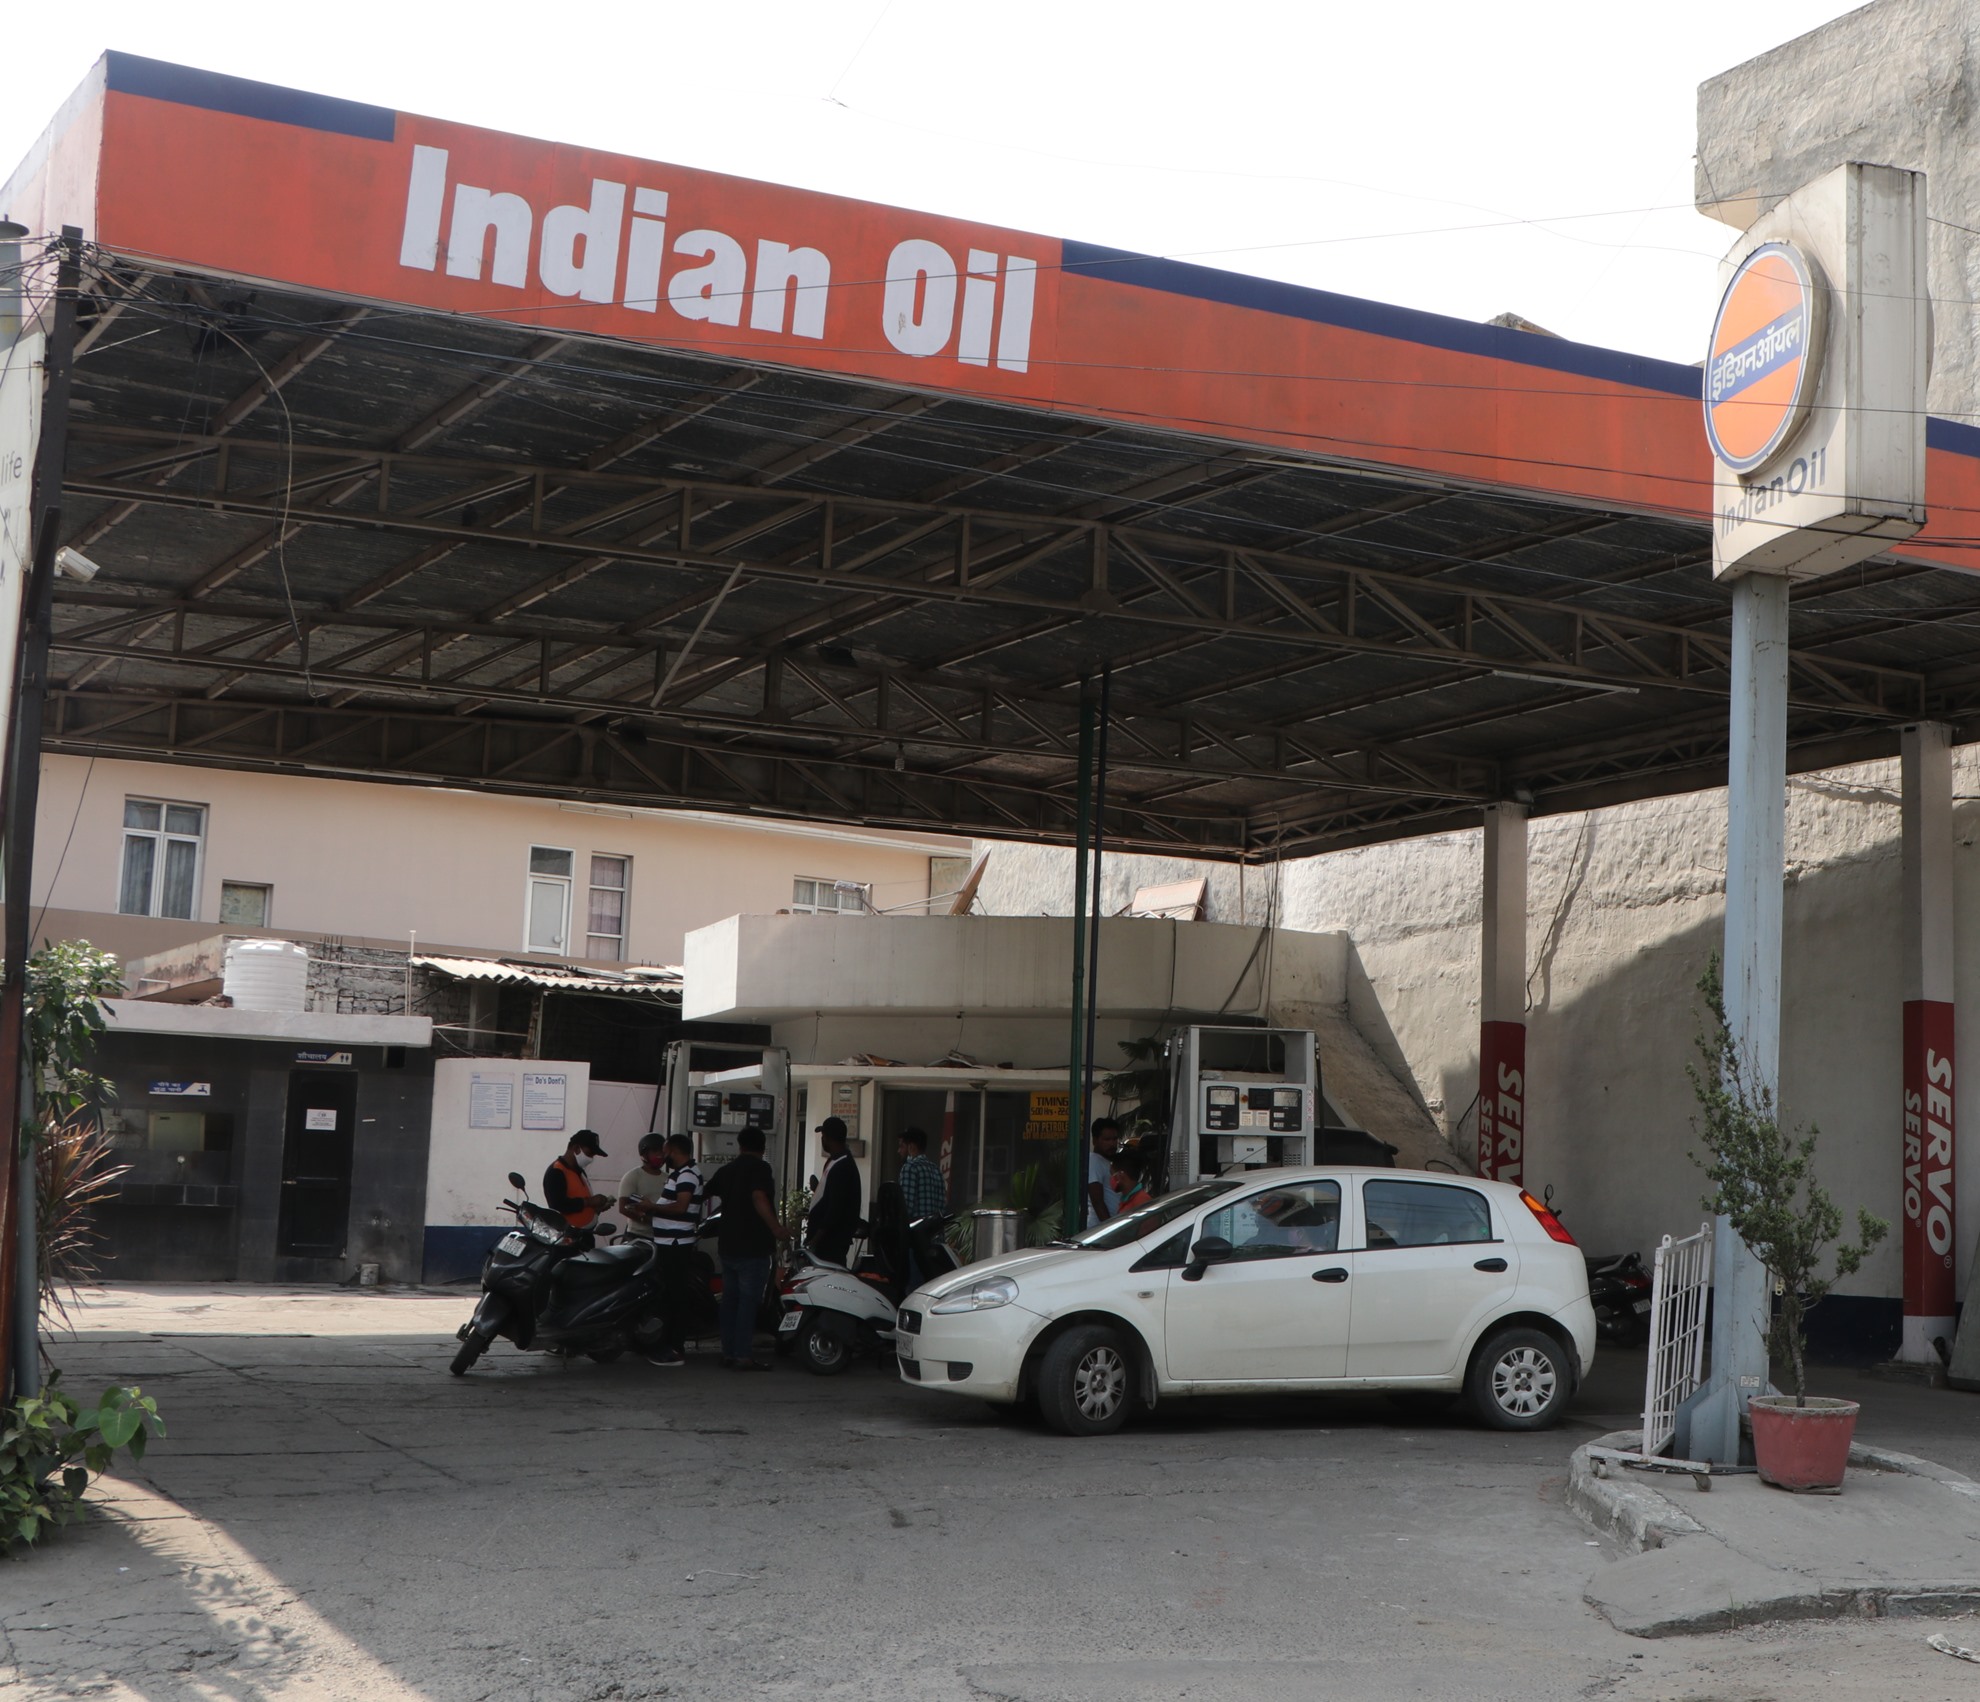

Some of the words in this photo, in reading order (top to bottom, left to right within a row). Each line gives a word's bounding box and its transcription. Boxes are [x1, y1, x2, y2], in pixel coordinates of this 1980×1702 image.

[400, 144, 830, 340] Indian
[883, 239, 1037, 374] Oil
[1711, 315, 1802, 401] इंडियनऑयल
[1, 449, 23, 486] life
[1480, 1095, 1493, 1181] SERV
[1497, 1060, 1523, 1187] SERV
[1904, 1088, 1922, 1220] SERVO
[1926, 1047, 1953, 1256] SERVO
